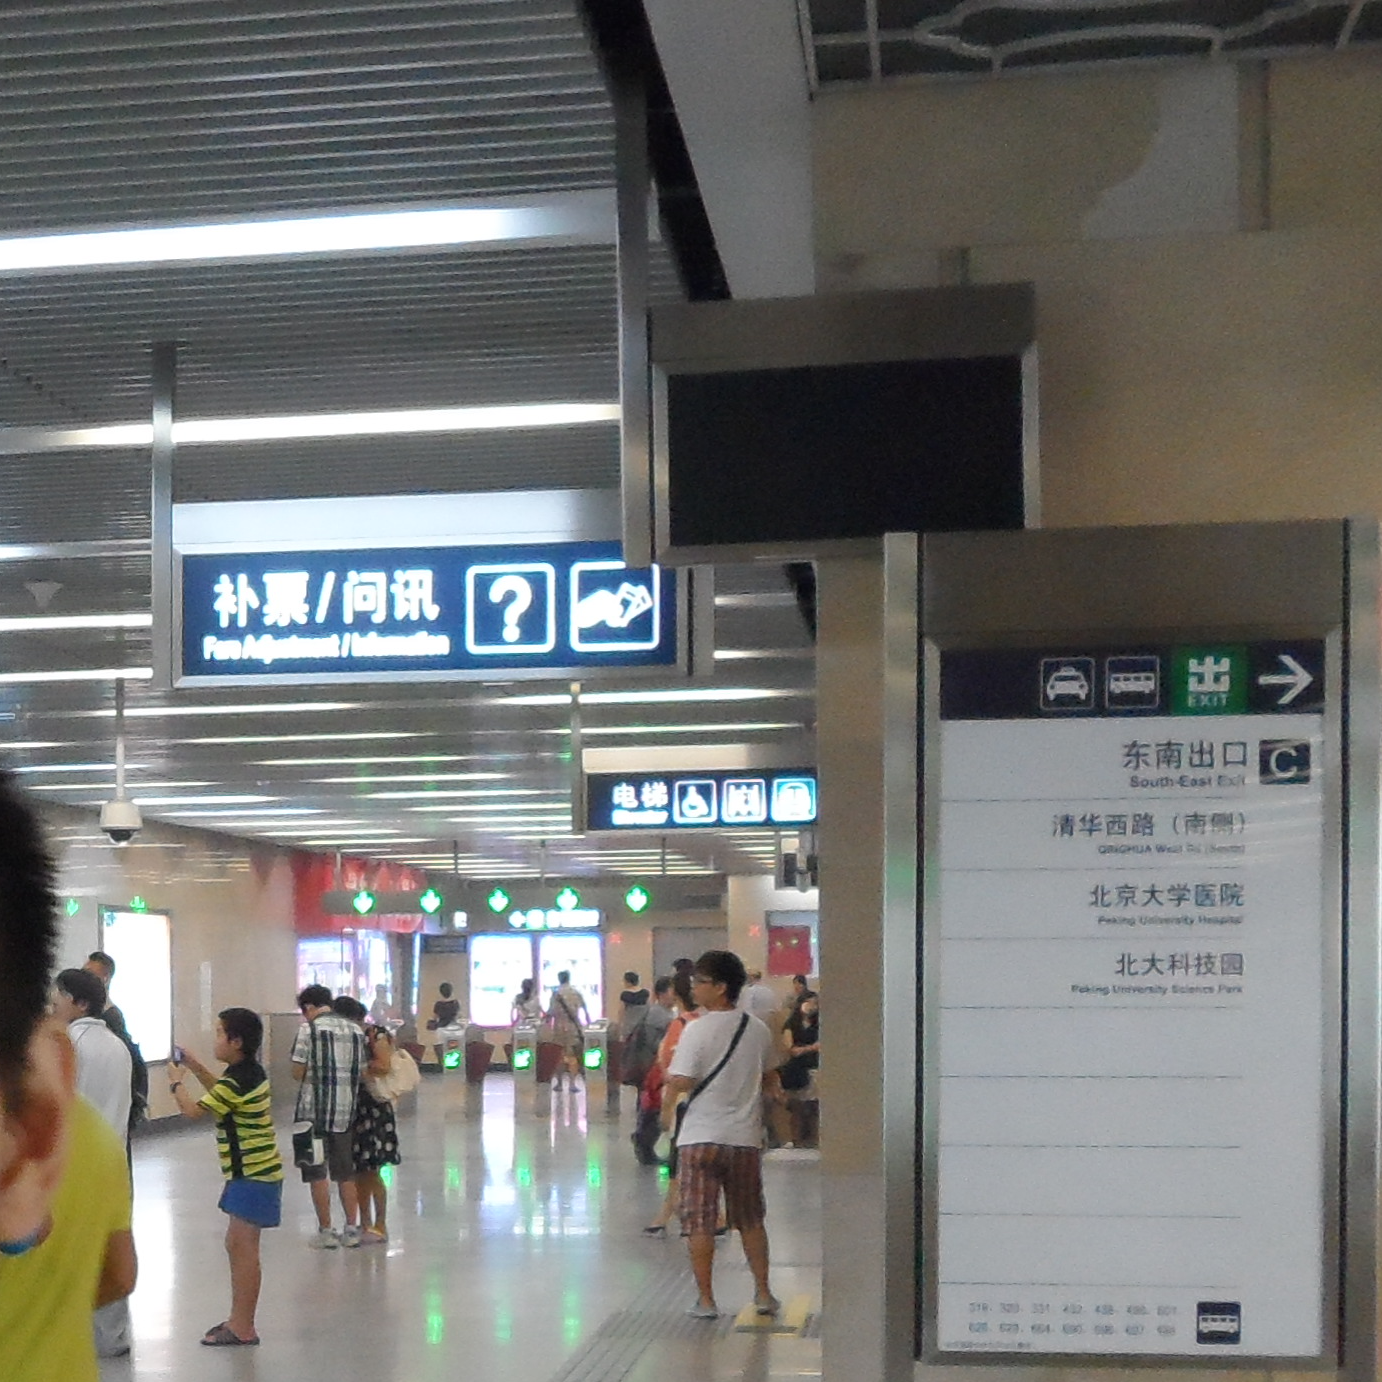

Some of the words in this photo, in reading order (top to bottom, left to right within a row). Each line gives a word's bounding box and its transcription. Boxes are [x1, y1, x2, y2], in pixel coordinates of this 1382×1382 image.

[213, 568, 441, 628] 补票/问讯
[1187, 693, 1228, 708] EXIT
[1122, 739, 1247, 770] 东南出口
[1269, 746, 1298, 778] C
[1129, 774, 1213, 788] South-East
[613, 782, 668, 808] 电梯
[1089, 882, 1245, 908] 北京大学医院
[1114, 952, 1245, 977] 北大科技园
